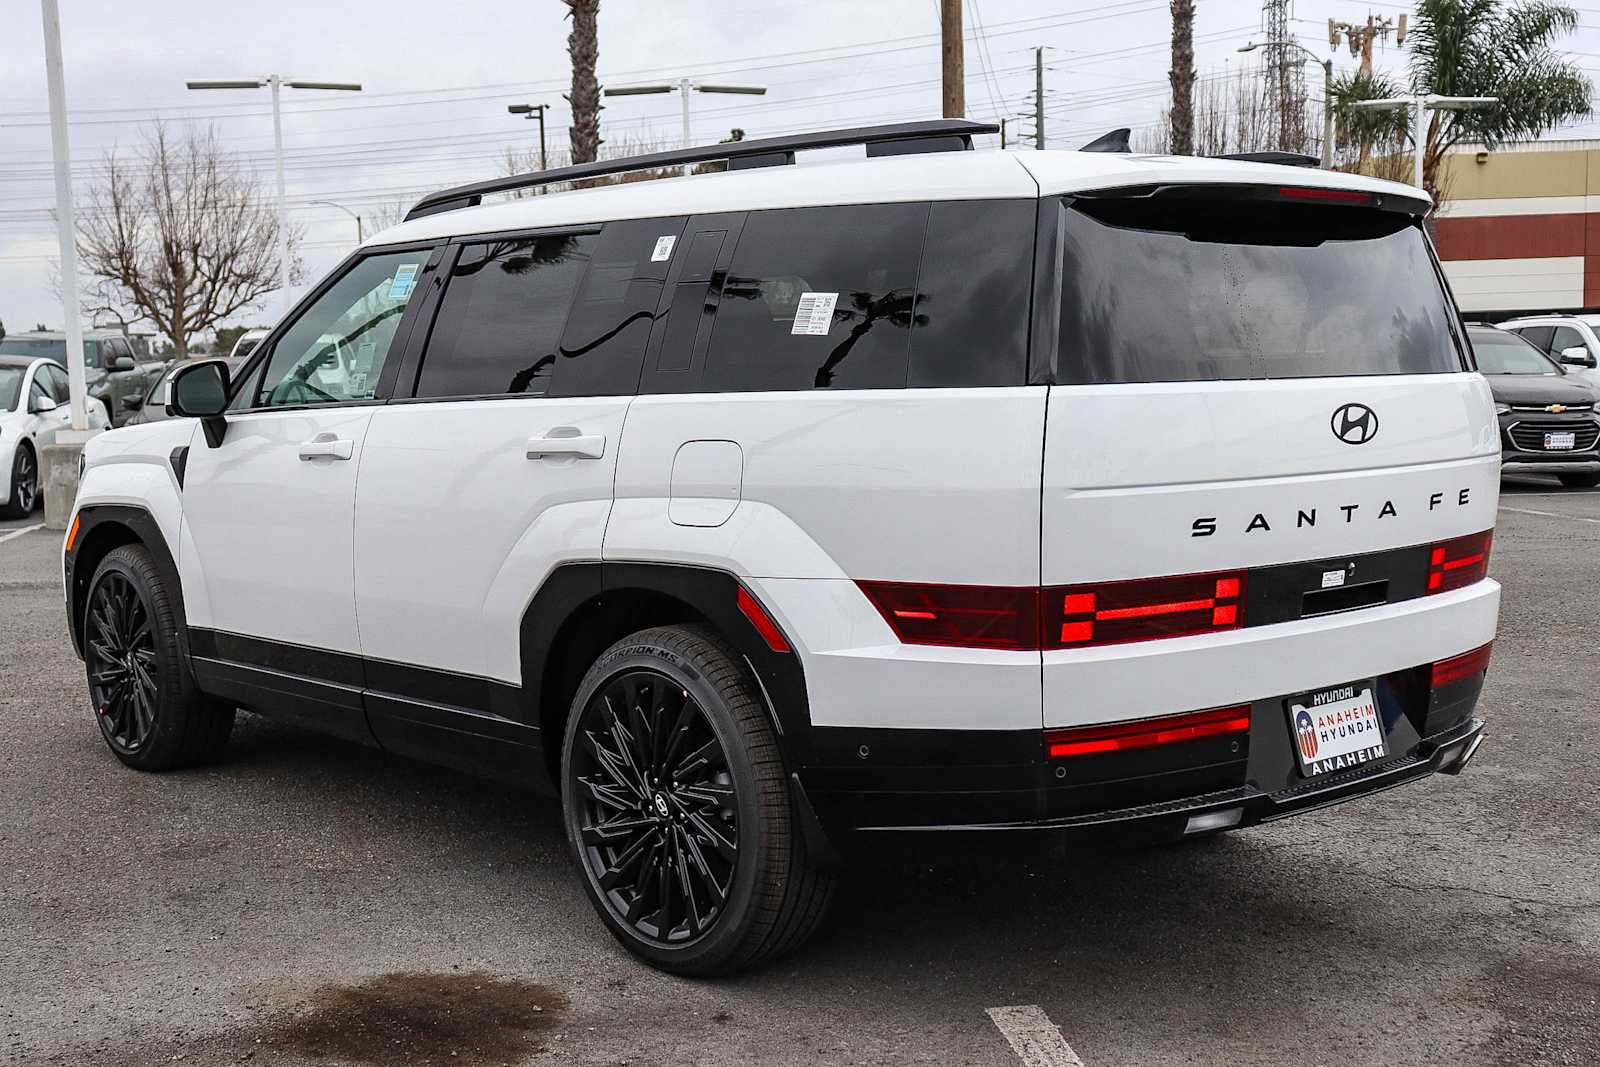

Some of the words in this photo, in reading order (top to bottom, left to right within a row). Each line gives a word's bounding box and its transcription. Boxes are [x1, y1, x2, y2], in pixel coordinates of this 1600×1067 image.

[1191, 501, 1397, 537] SANTA
[1429, 488, 1470, 510] FE
[1313, 686, 1354, 705] HYUNDAI
[1318, 703, 1374, 728] ANAHEIM
[1320, 718, 1377, 743] HYUNDAI
[1312, 745, 1385, 775] ANAHEIM
